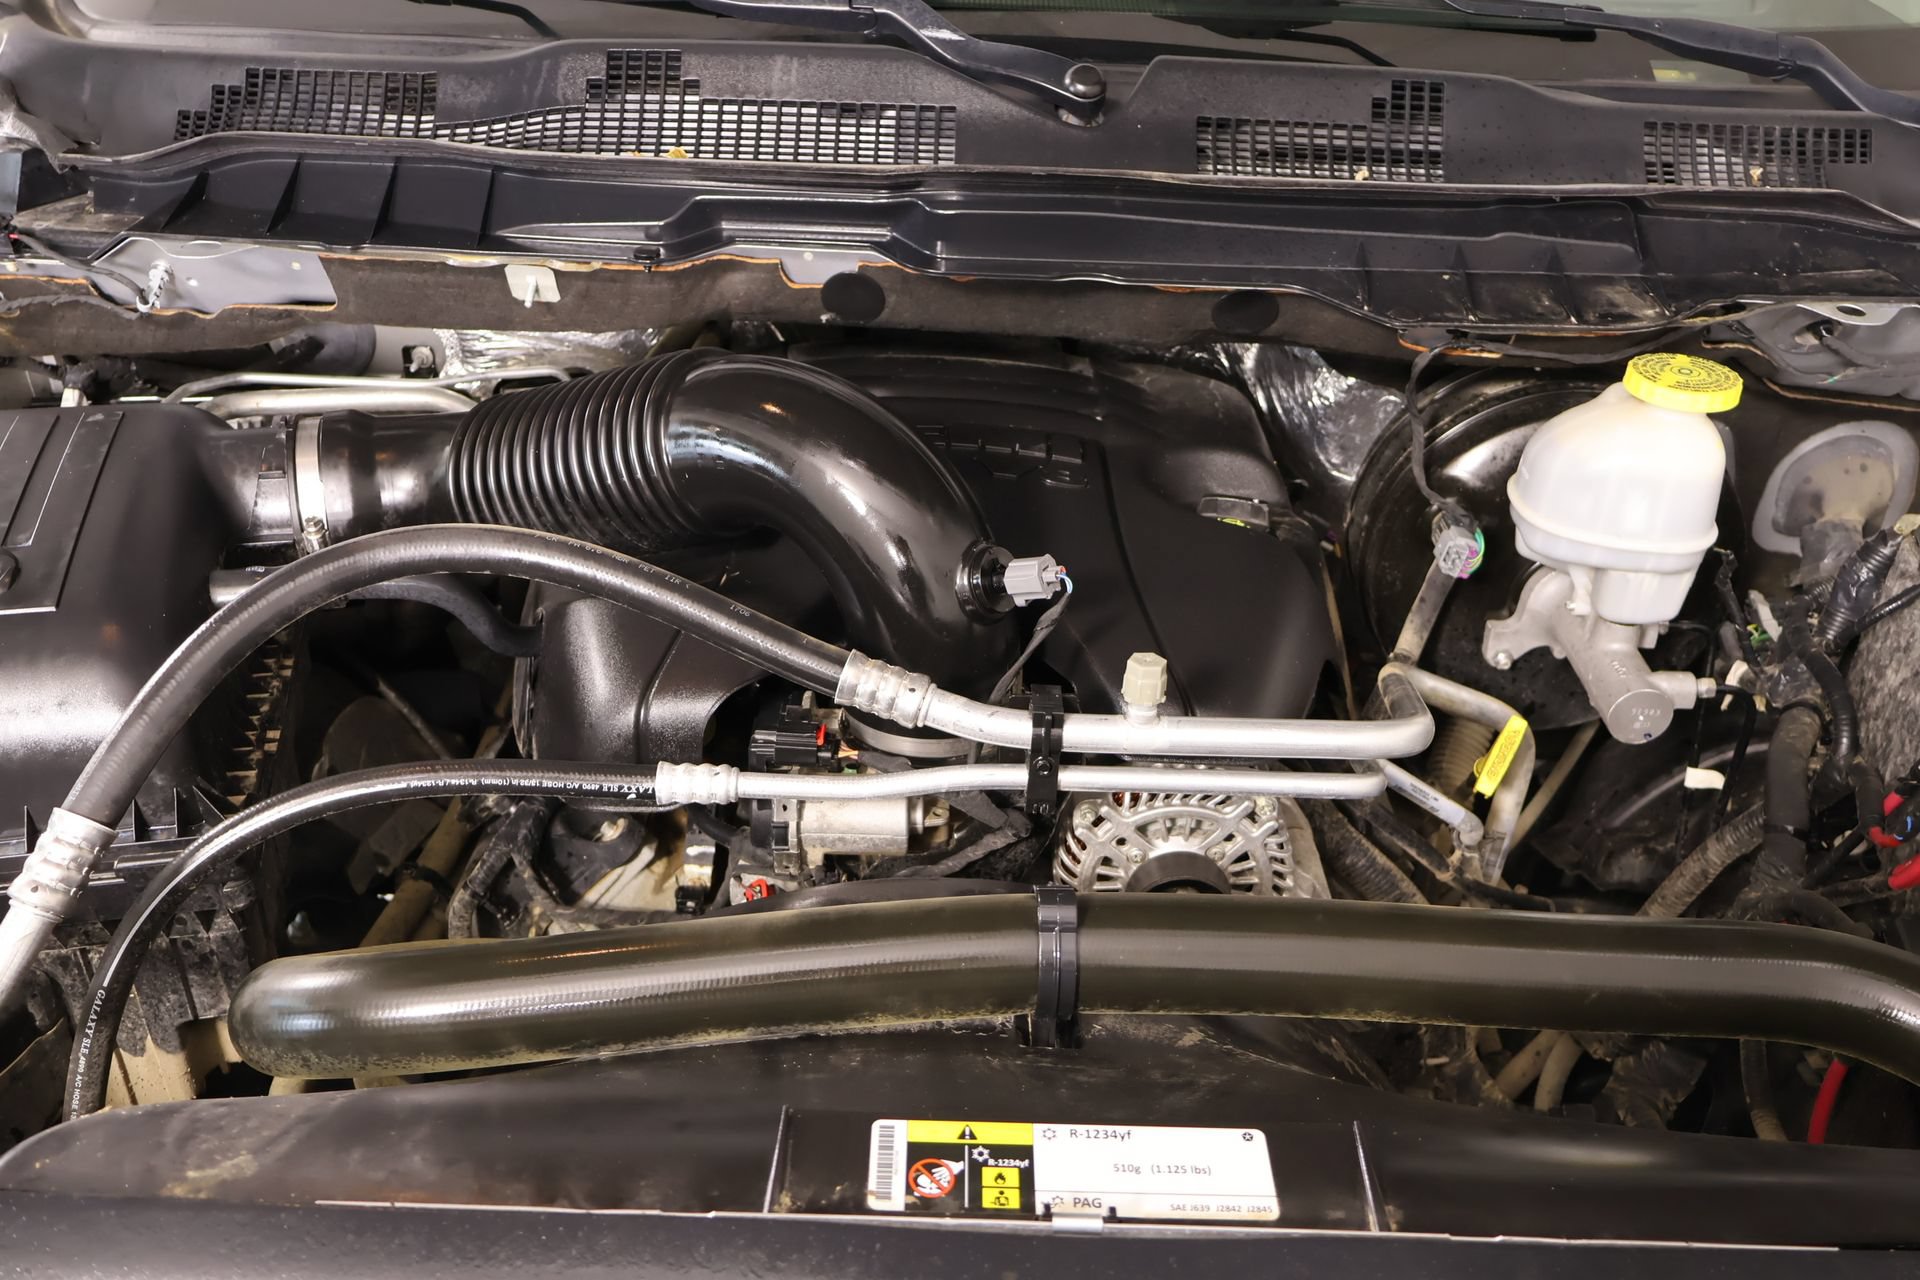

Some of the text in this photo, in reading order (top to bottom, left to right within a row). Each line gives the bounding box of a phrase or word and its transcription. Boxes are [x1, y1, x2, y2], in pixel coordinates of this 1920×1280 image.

[481, 777, 510, 787] (10mm)
[541, 779, 565, 788] HOSE
[566, 781, 580, 789] A/C
[602, 783, 619, 792] SLE
[85, 989, 106, 1037] GALAXY
[80, 1037, 92, 1055] SLE
[78, 1055, 87, 1073] 4890
[75, 1074, 83, 1087] A/C
[72, 1089, 81, 1110] HOSE
[1069, 1128, 1131, 1141] R-1234yf
[987, 1158, 1030, 1168] R-1234yf
[1113, 1163, 1212, 1176] 510g (1.125 lbs)
[1072, 1197, 1103, 1209] PAG
[1170, 1203, 1273, 1213] SAE J639 J2842 J2845
